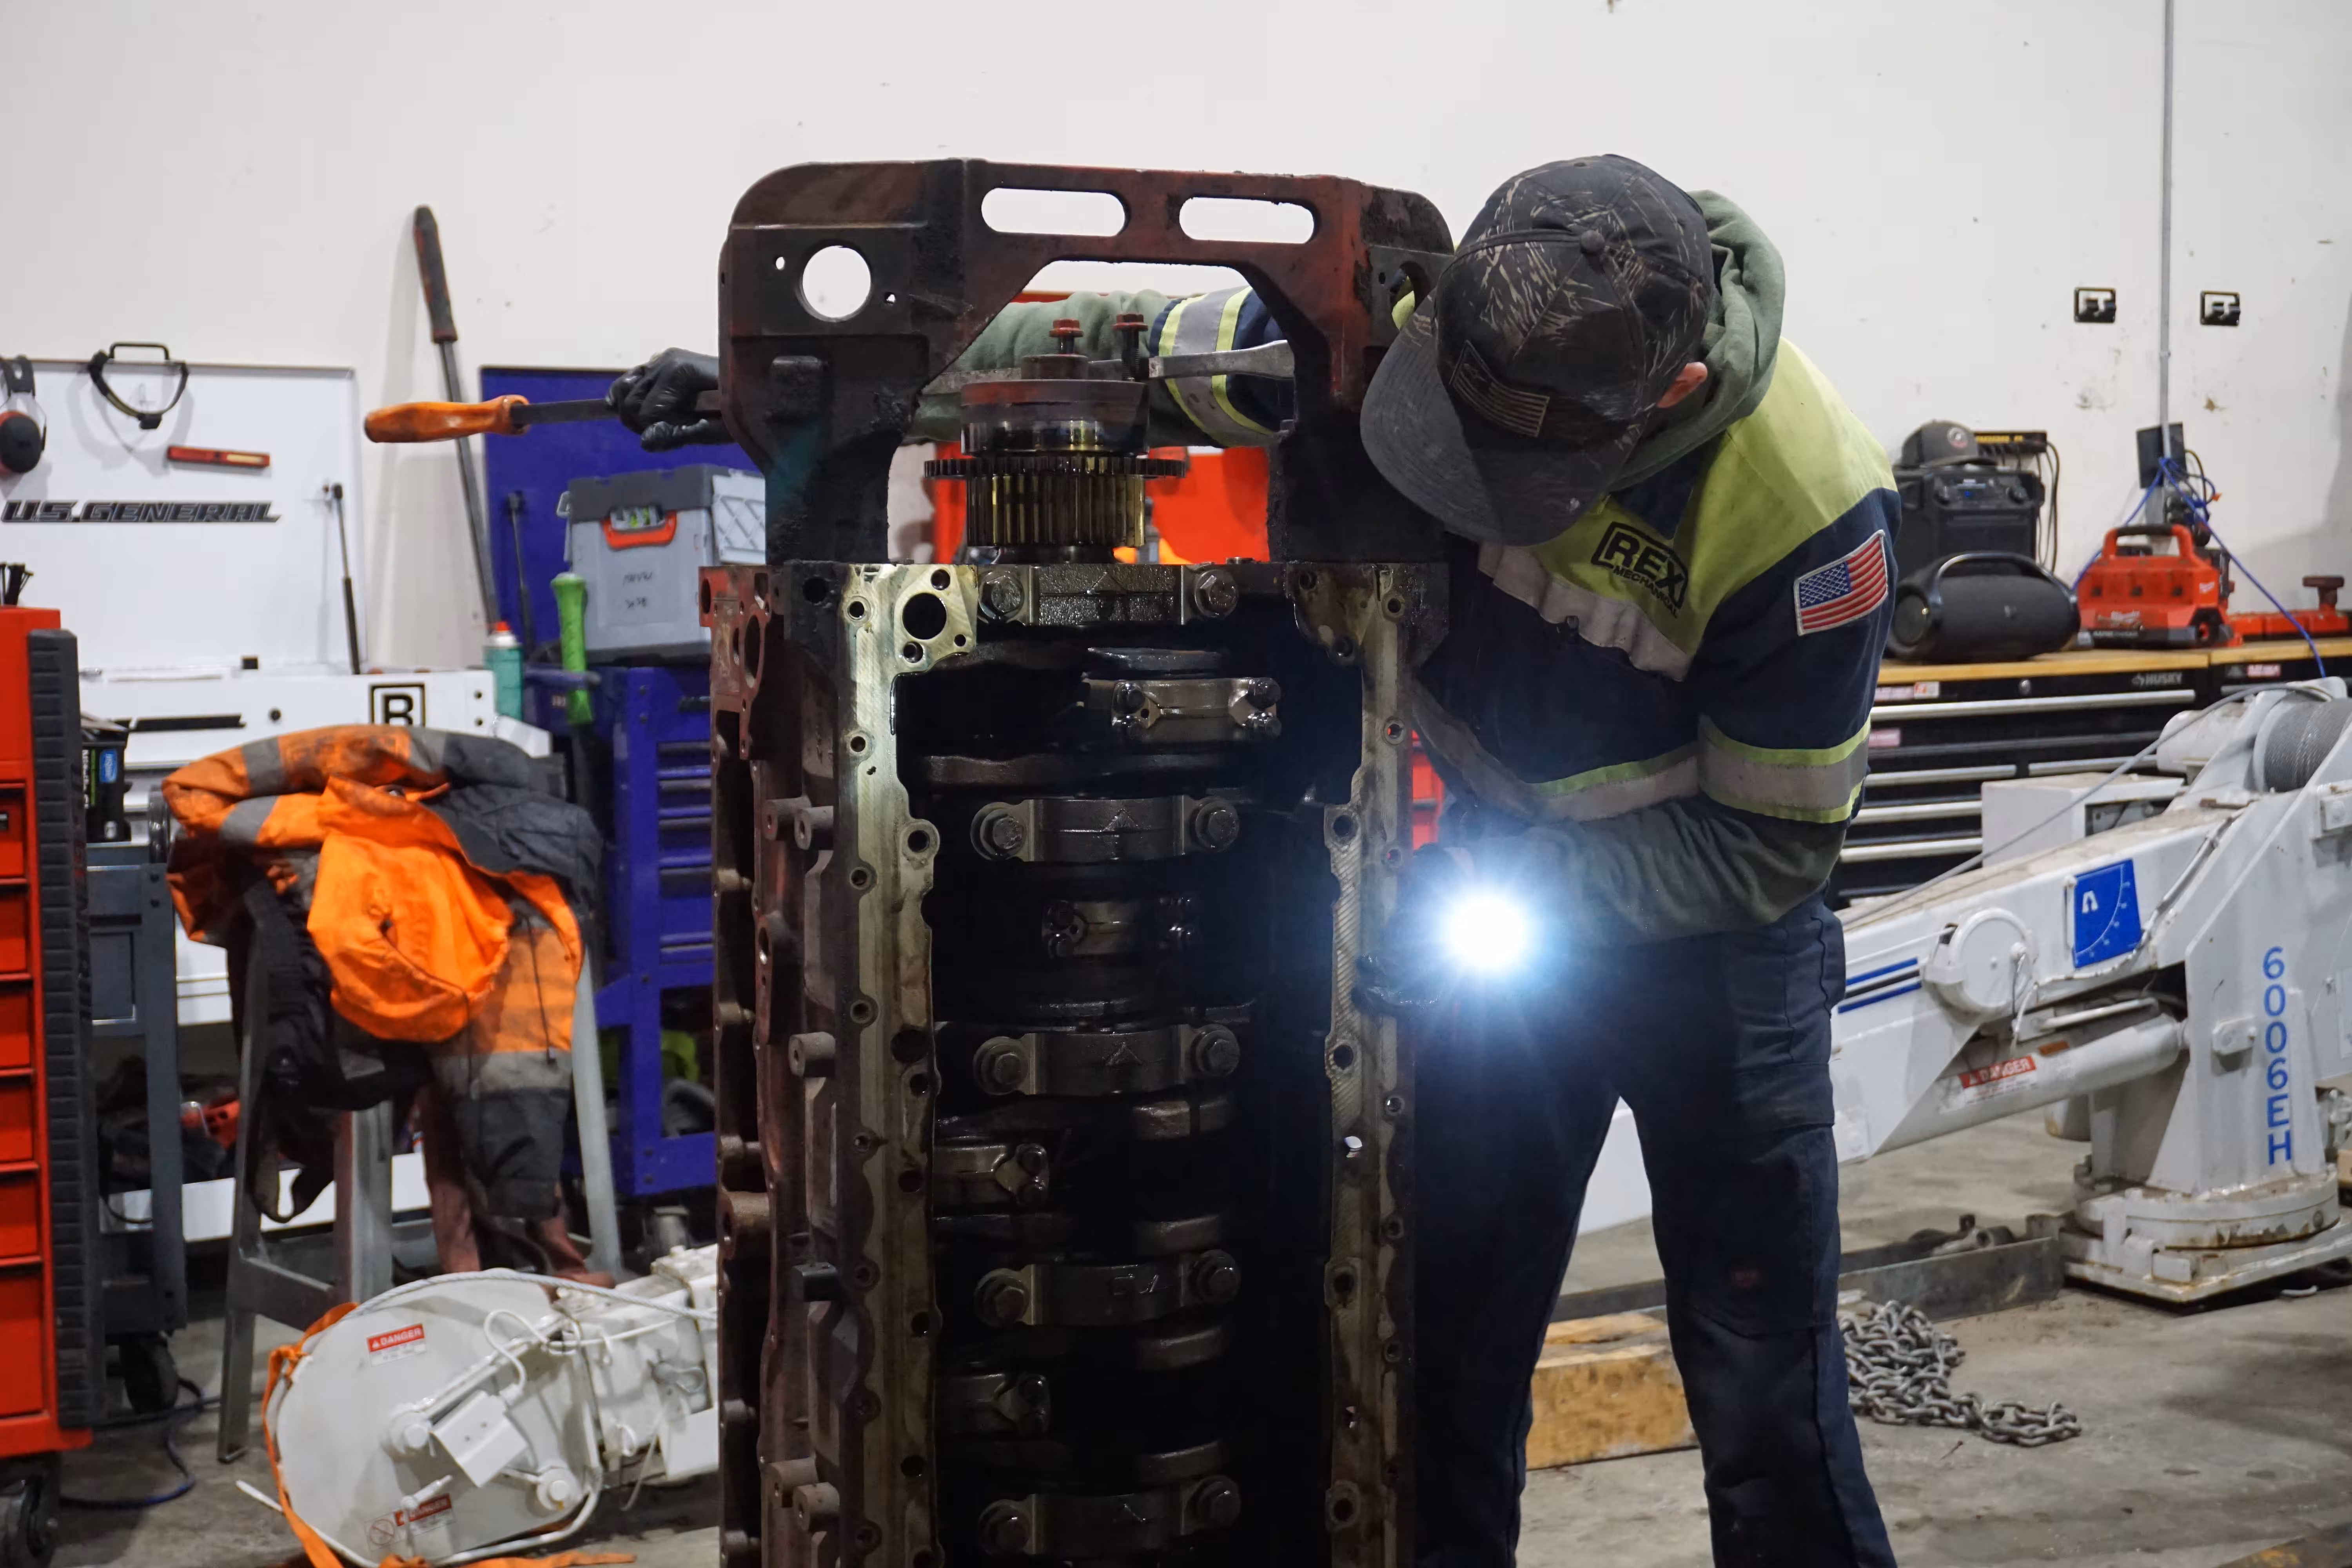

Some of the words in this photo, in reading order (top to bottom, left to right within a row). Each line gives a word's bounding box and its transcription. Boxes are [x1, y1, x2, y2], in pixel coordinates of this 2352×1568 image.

[1604, 531, 1685, 608] REX
[1612, 566, 1678, 619] MECHANICAL
[2145, 671, 2182, 686] HUSKY
[379, 1327, 421, 1346] DANGER
